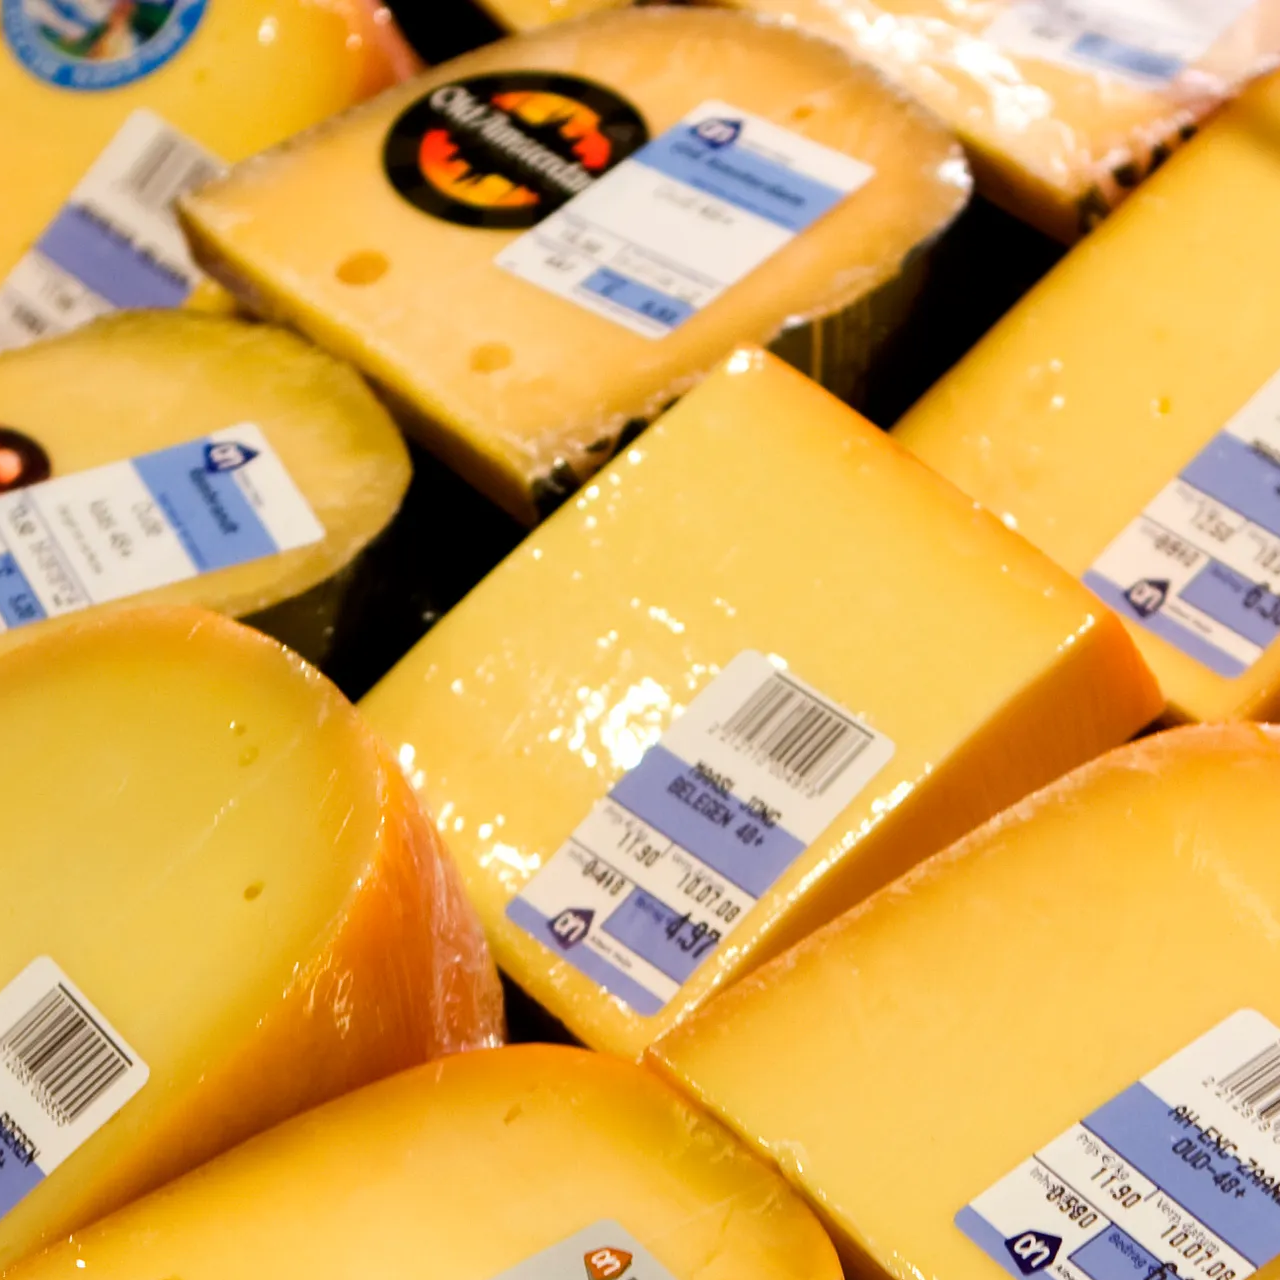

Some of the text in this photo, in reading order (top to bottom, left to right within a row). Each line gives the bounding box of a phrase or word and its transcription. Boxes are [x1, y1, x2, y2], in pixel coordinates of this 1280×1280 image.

[666, 776, 736, 828] BELEGEN
[615, 832, 742, 923] 11.90 10.07.08
[660, 909, 722, 961] 4.97
[1087, 1166, 1143, 1209] 11.90
[1170, 1137, 1251, 1201] OUD-48+
